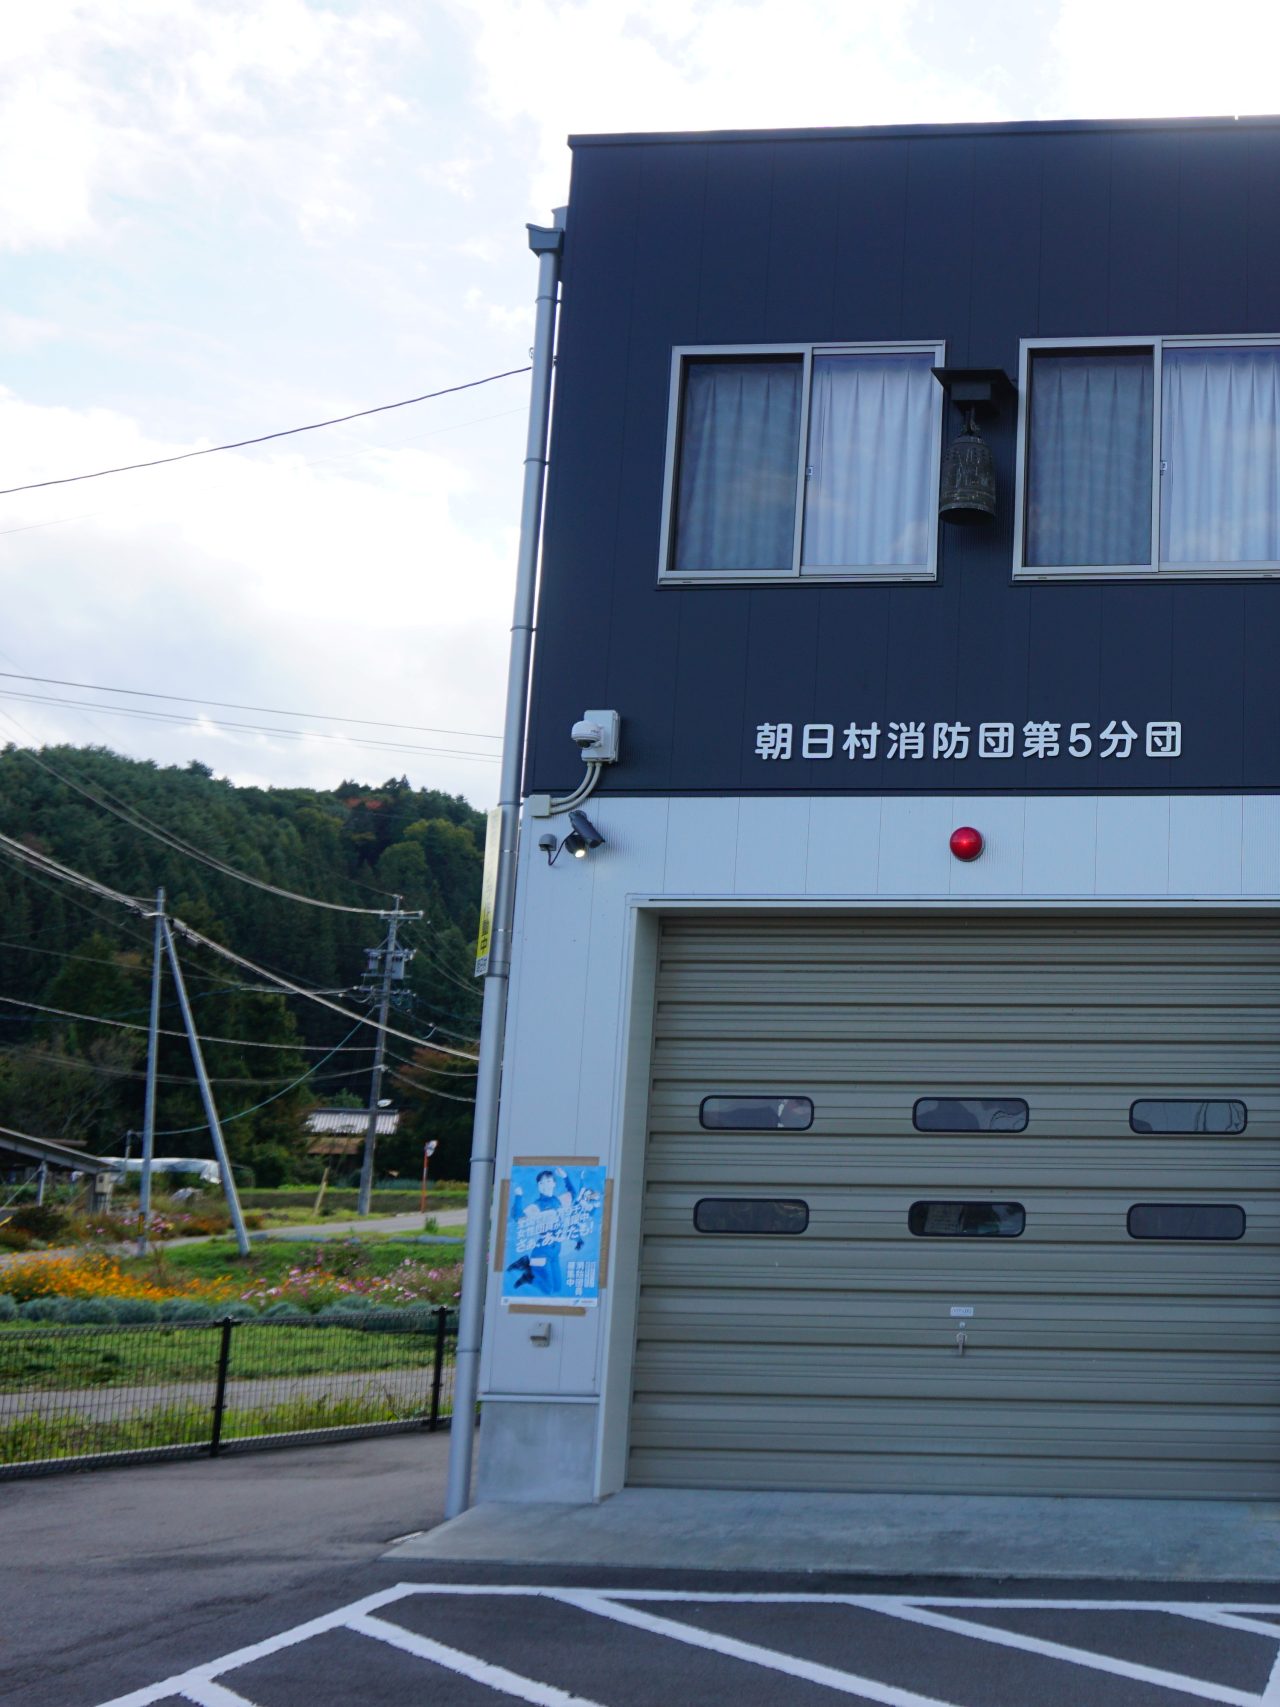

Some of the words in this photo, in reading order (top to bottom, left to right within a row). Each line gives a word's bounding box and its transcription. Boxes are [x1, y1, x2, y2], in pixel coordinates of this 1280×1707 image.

[754, 720, 1182, 760] 朝日村消防団第5分団
